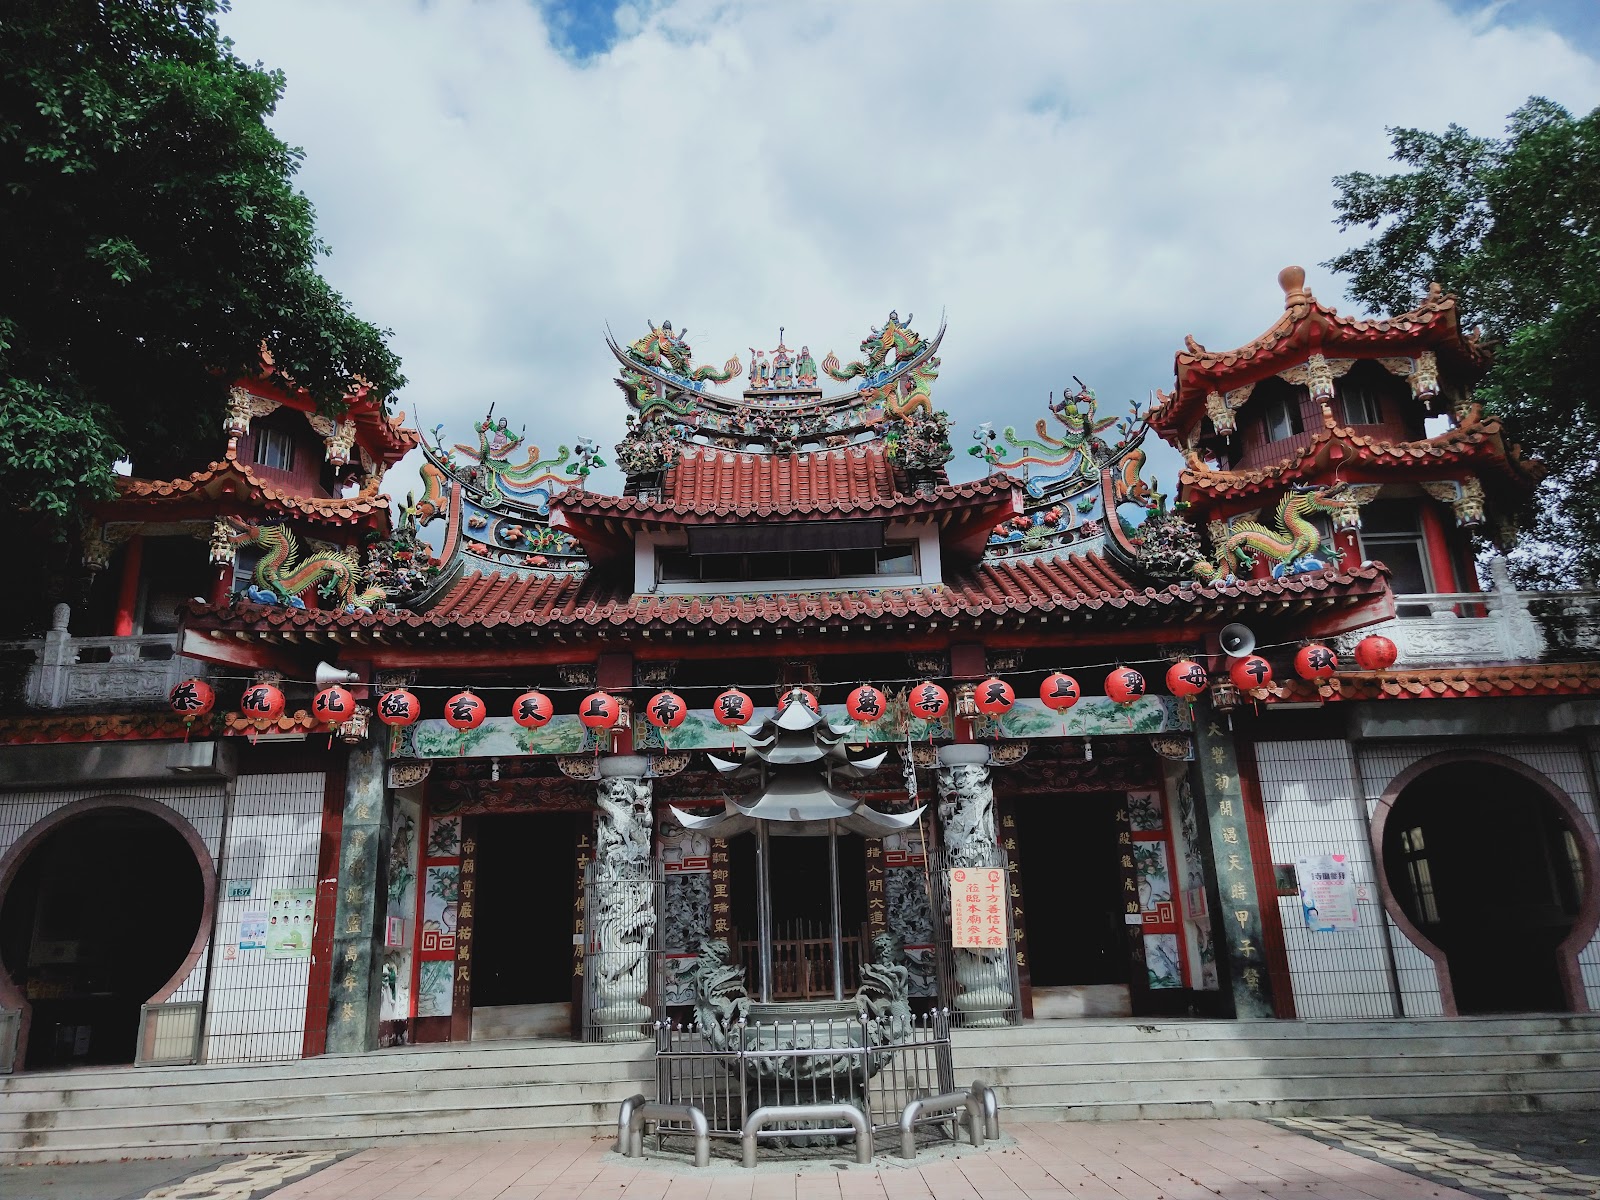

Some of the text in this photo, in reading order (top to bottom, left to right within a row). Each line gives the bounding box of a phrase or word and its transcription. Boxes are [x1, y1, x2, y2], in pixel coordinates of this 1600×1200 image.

[984, 648, 1337, 706] 天 上 聖 母 千 秋
[170, 682, 945, 721] 恭 祝 北 極 玄 天 上 帝 聖 萬 壽
[233, 888, 250, 896] 137
[985, 883, 1003, 946] 十方善信大德
